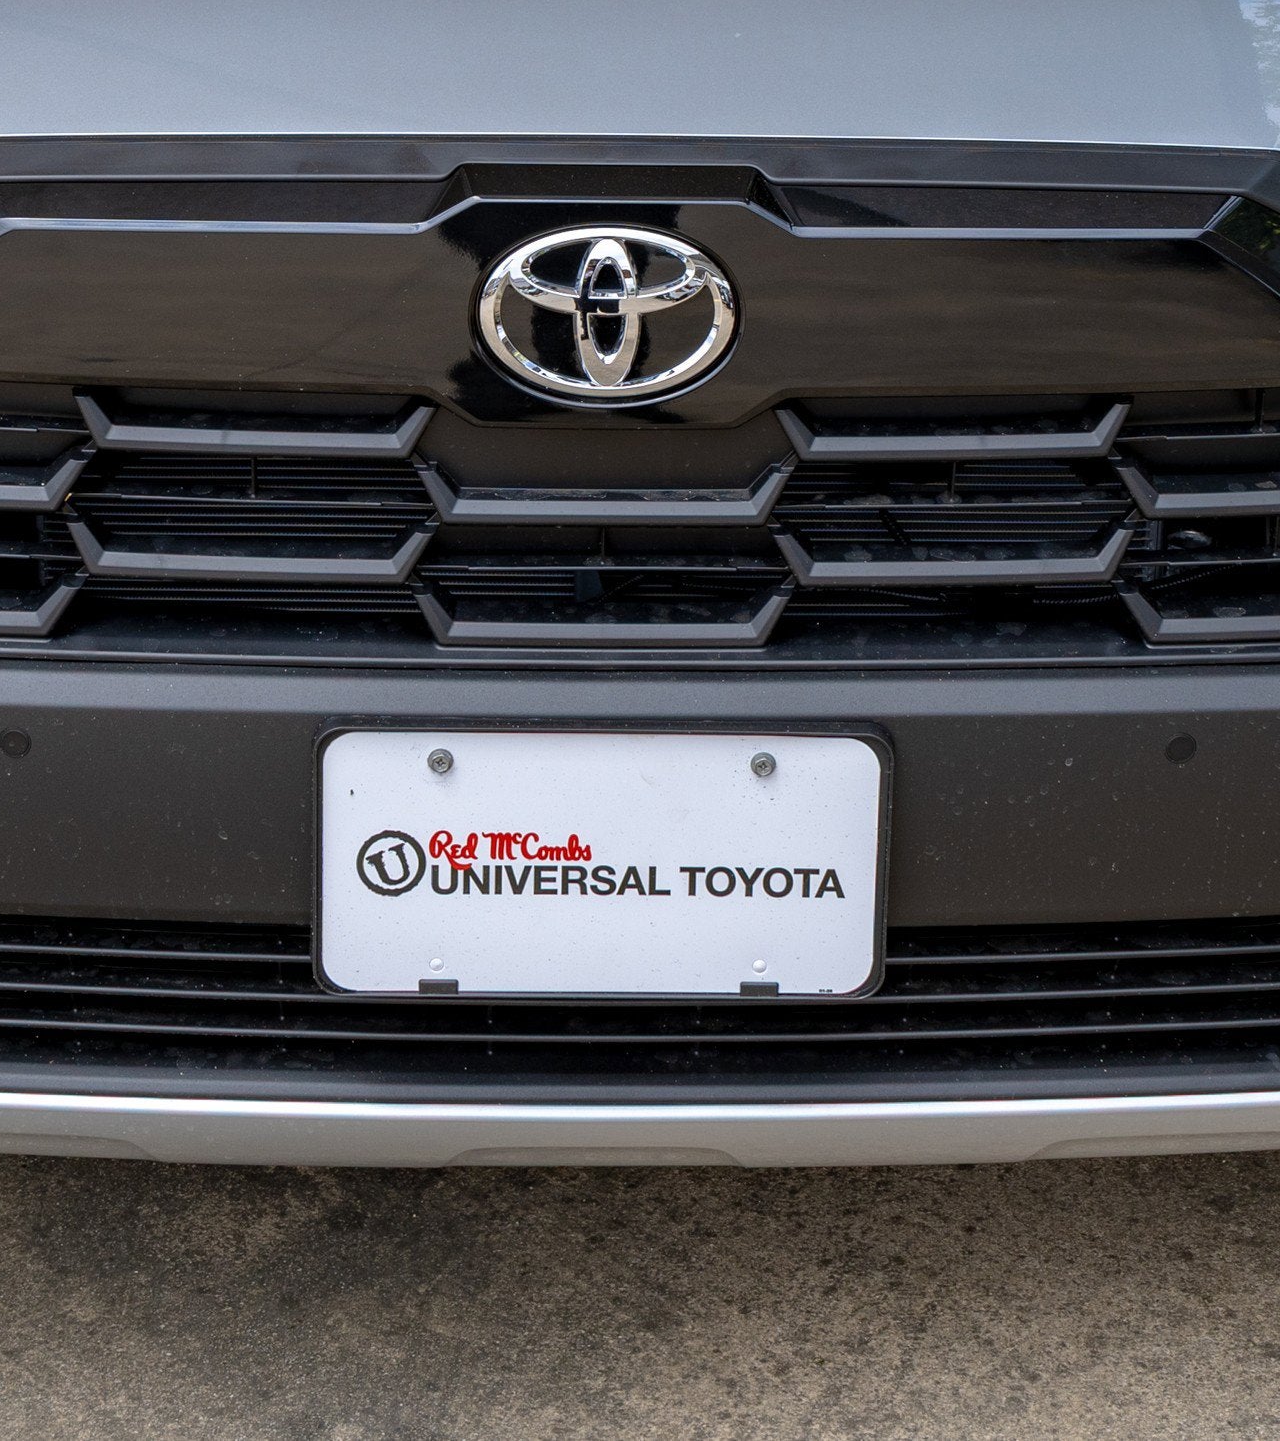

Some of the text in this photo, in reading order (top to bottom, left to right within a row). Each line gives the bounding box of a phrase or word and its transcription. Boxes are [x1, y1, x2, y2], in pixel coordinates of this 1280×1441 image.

[429, 829, 592, 871] Red McCombs
[431, 864, 846, 899] UNIVERSAL TOYOTA
